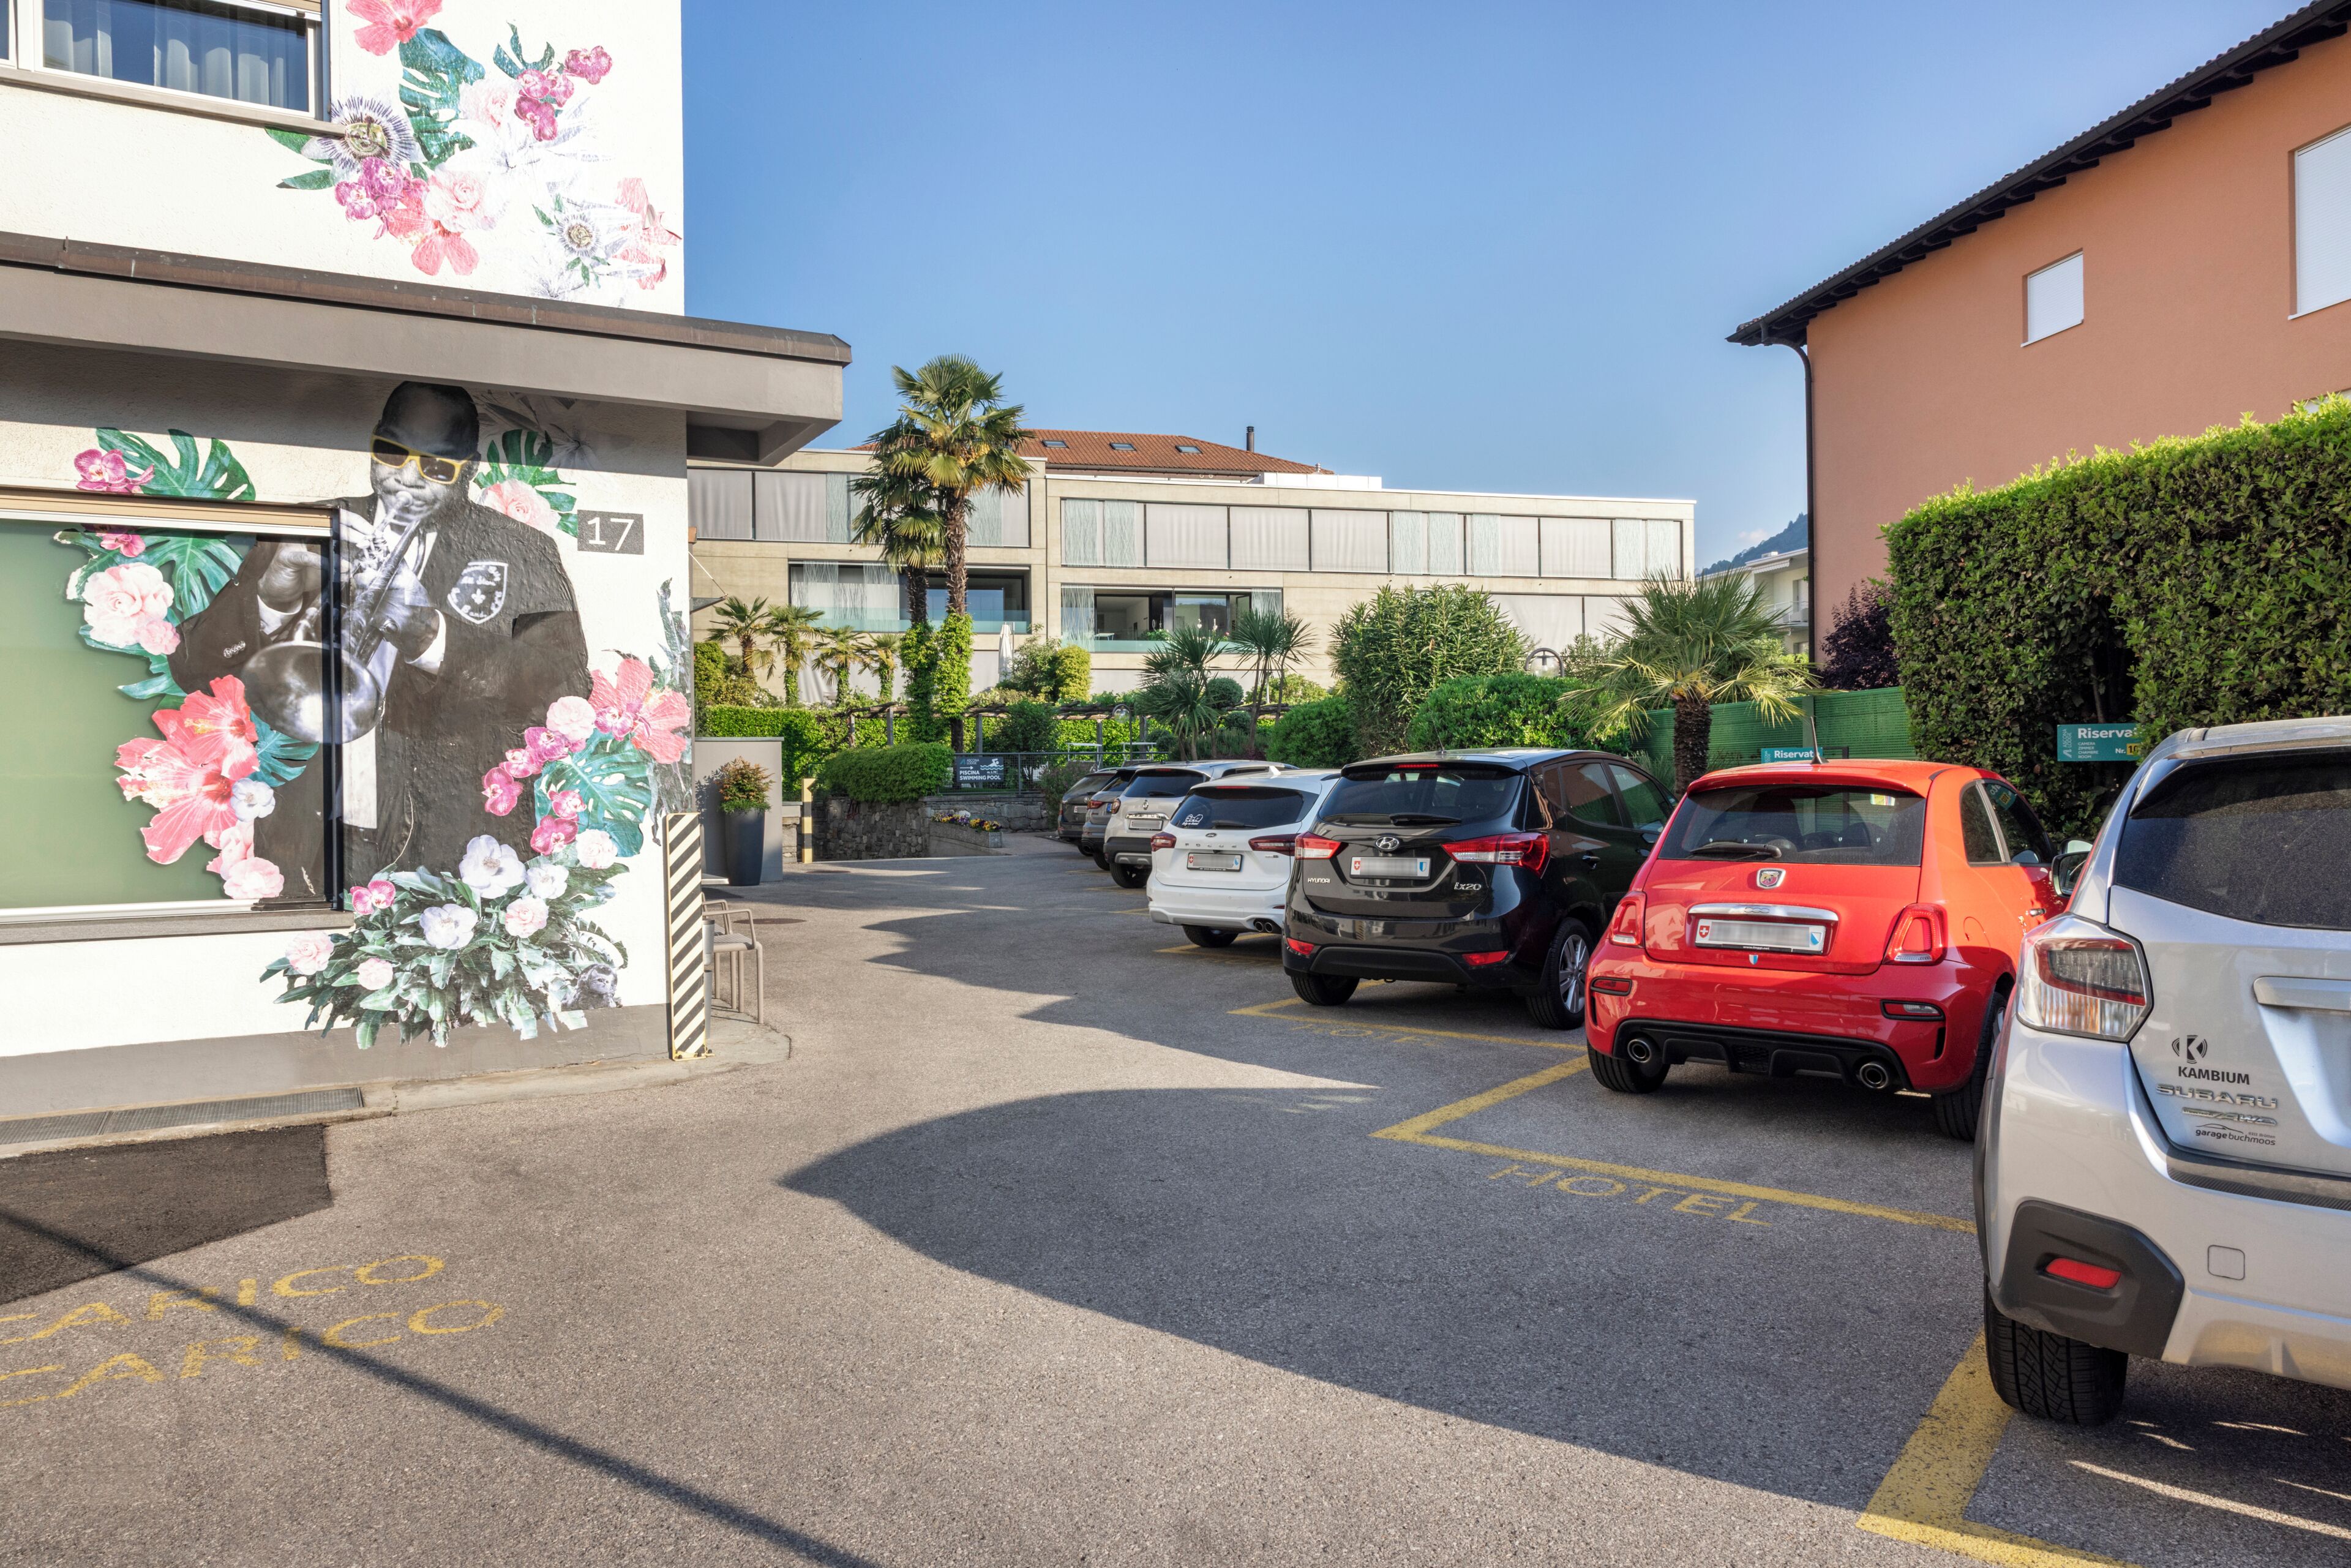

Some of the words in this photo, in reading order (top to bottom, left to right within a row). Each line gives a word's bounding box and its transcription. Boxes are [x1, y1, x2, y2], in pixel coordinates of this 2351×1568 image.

[588, 517, 634, 551] 17
[2078, 727, 2141, 739] Riserva
[2178, 1066, 2251, 1085] KAMBIUM
[2156, 1083, 2278, 1109] SUBARU
[2195, 1129, 2228, 1139] garage
[2229, 1133, 2276, 1146] buchmoos
[1486, 1164, 1774, 1226] HOTEL
